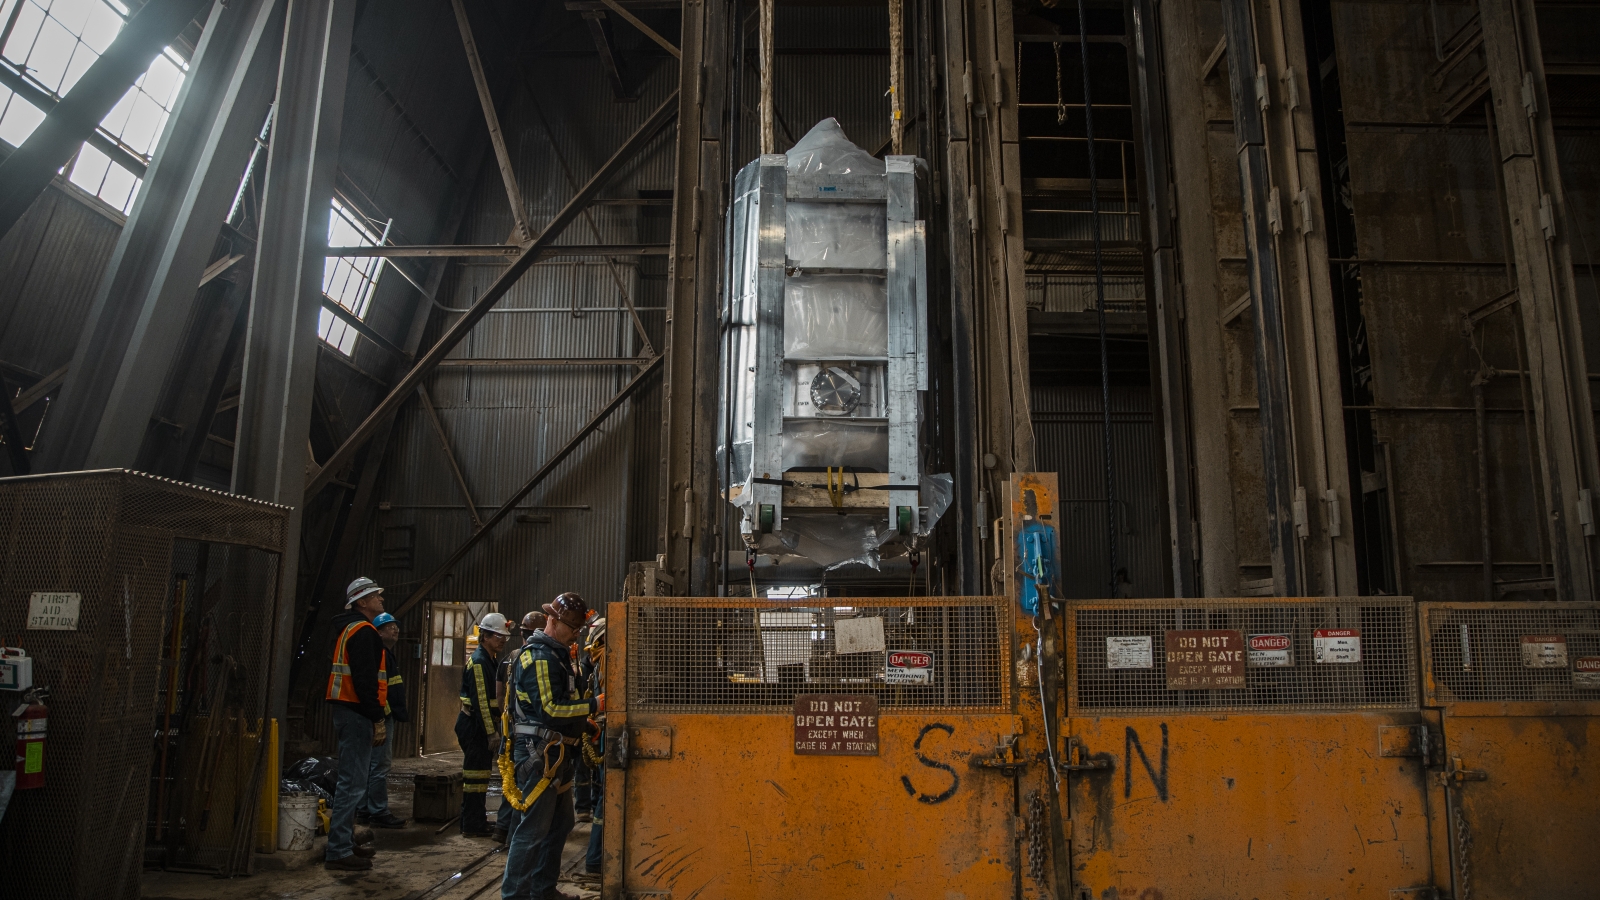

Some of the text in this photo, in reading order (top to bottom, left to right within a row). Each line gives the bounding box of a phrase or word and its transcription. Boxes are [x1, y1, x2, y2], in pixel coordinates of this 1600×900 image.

[40, 594, 71, 604] FIRST
[42, 605, 61, 615] AID
[31, 616, 75, 628] STATION
[1179, 636, 1229, 648] DO NOT
[1251, 638, 1288, 648] DANGER
[1167, 650, 1242, 663] OPEN GATE
[1179, 665, 1232, 675] EXCEPT WHEN
[1576, 660, 1600, 669] DANG
[1168, 675, 1245, 686] CAGE IS AT STATION
[809, 700, 862, 713] DO NOT
[796, 714, 876, 728] OPEN GATE
[808, 730, 864, 740] EXCEPT WHEN
[795, 741, 877, 751] CAGE IS AT STATION
[901, 722, 960, 805] S
[1124, 721, 1169, 804] N
